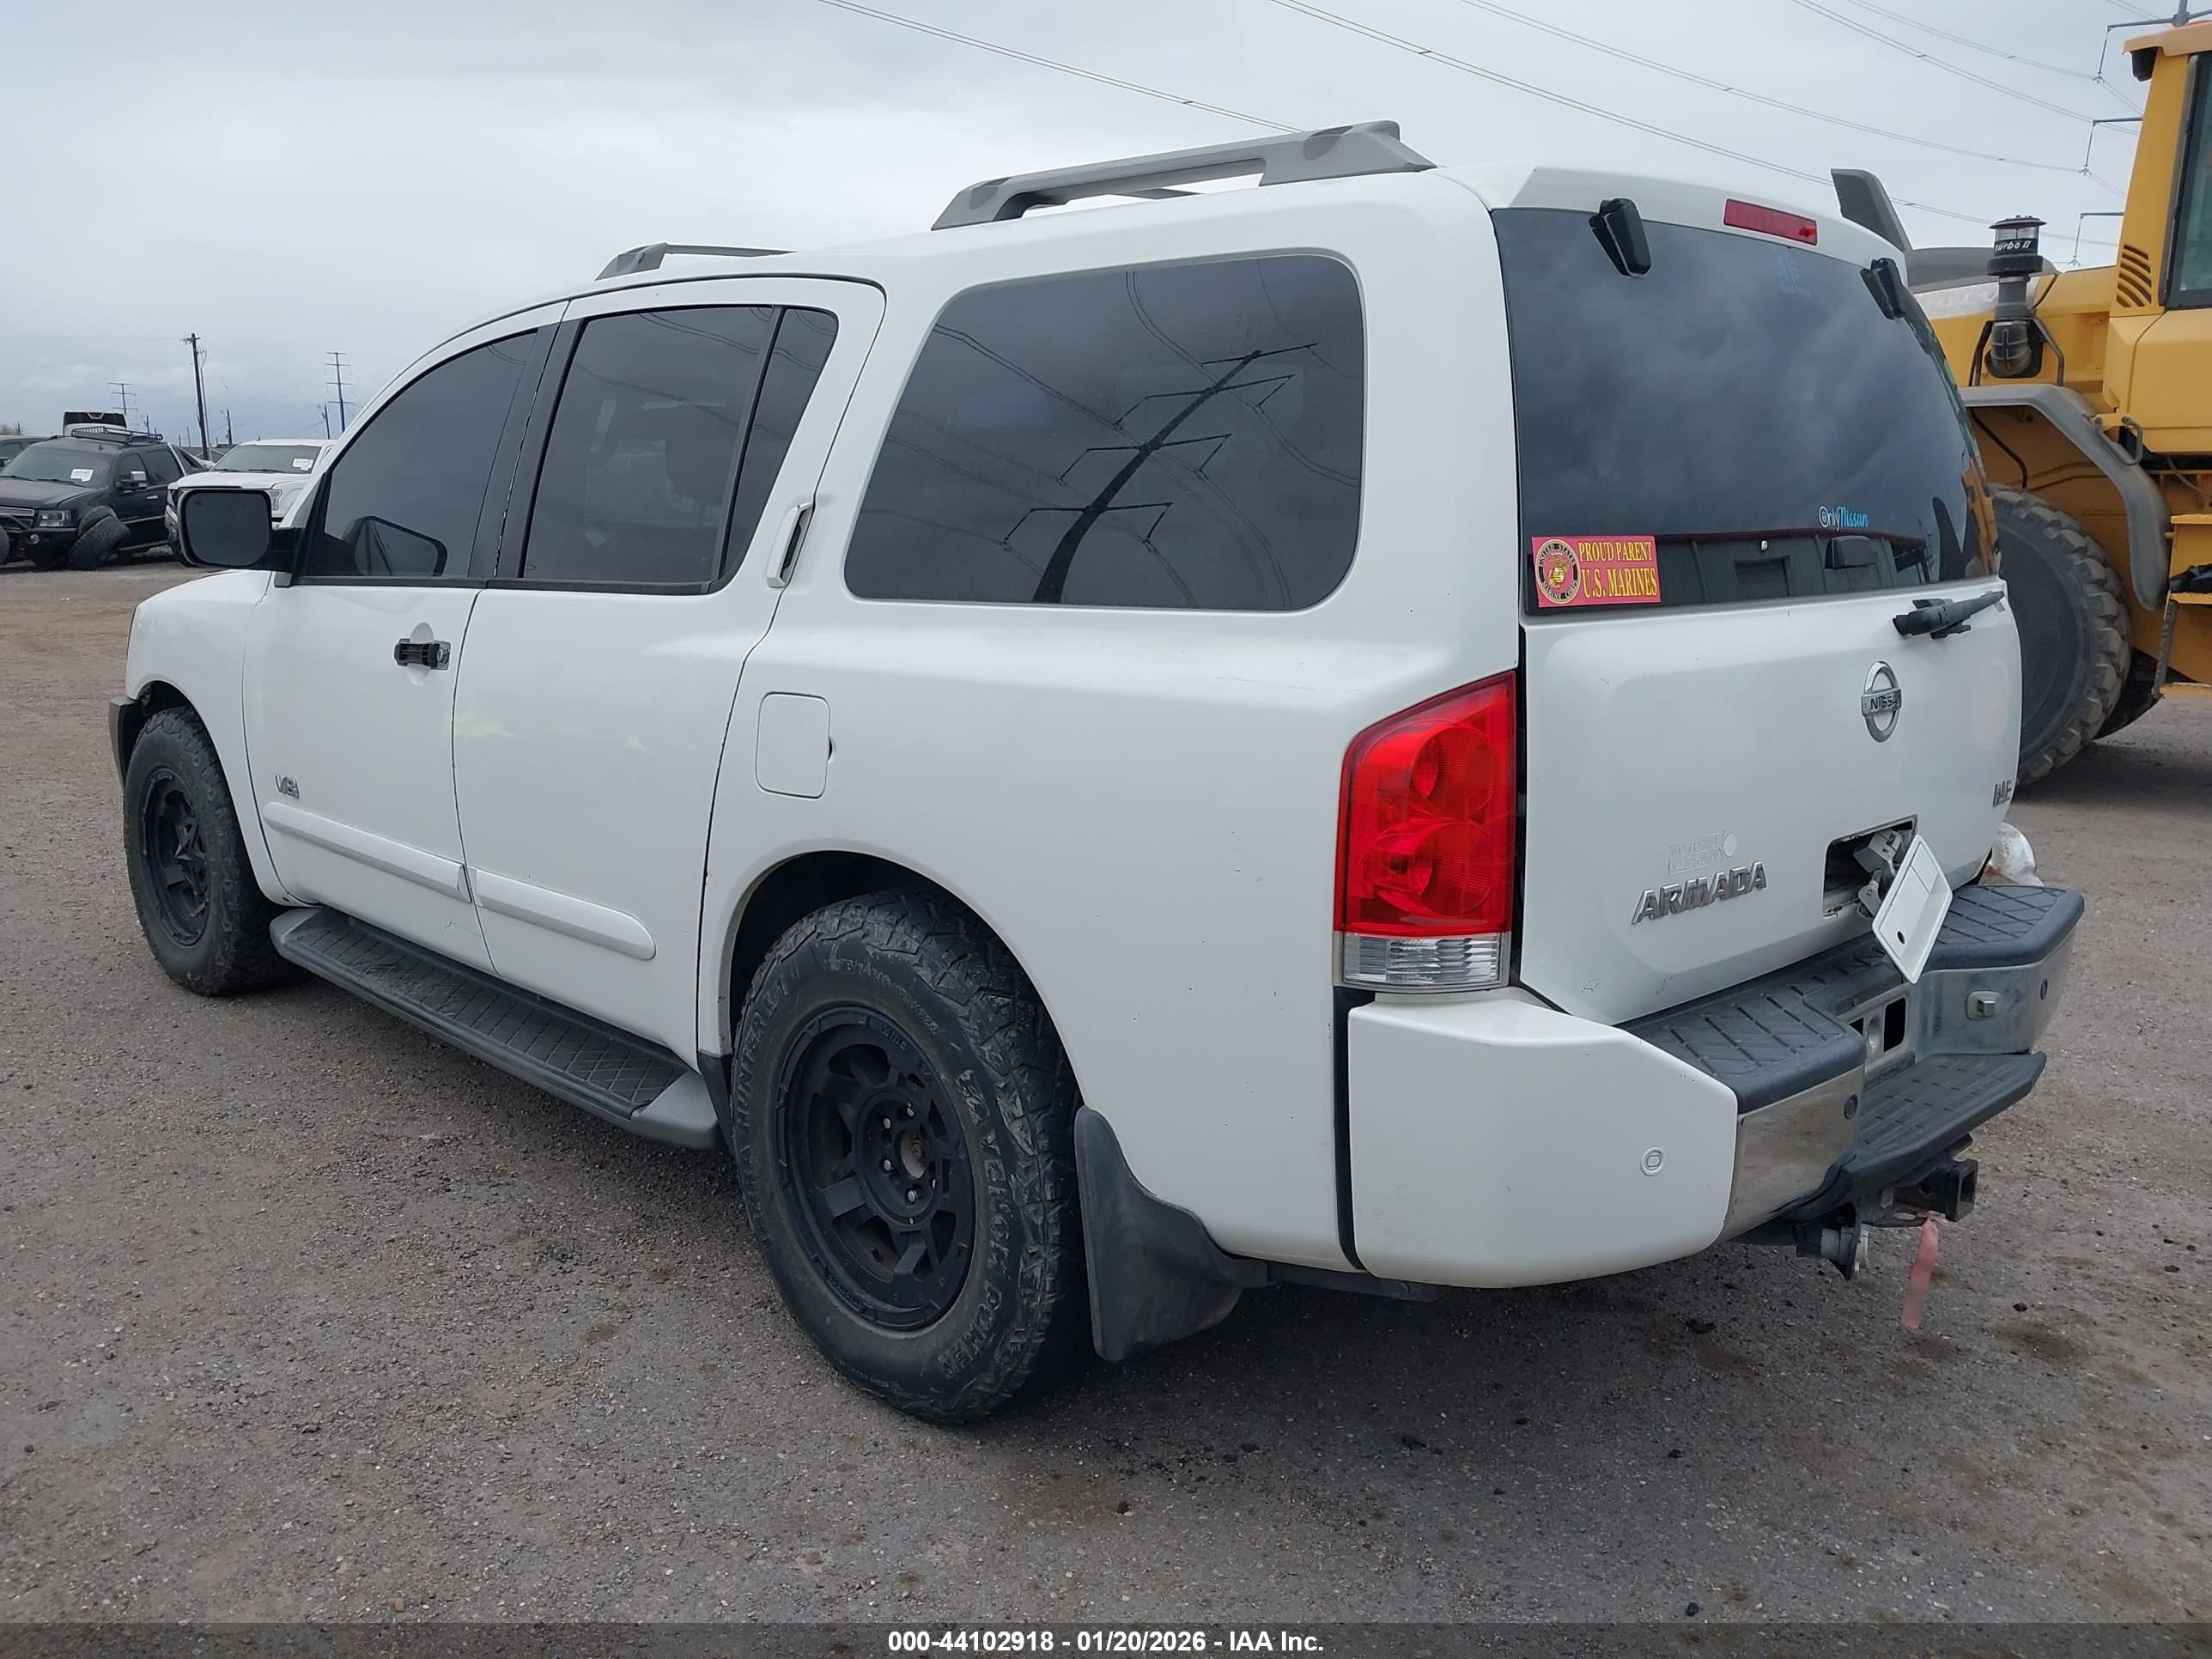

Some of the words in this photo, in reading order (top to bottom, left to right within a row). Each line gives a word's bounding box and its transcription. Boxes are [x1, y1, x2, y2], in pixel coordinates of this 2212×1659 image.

[1995, 241, 2021, 252] turbo
[1539, 543, 1556, 566] UNITED
[1559, 544, 1577, 566] STATES
[1578, 542, 1614, 562] PROUD
[1616, 542, 1653, 562] PARENT
[1542, 580, 1562, 600] MARINE
[1565, 580, 1578, 598] CORPS
[1582, 569, 1606, 599] U.S.
[1607, 568, 1657, 597] MARINES
[1870, 694, 1899, 710] NISSA
[1631, 861, 1767, 925] ARMADA
